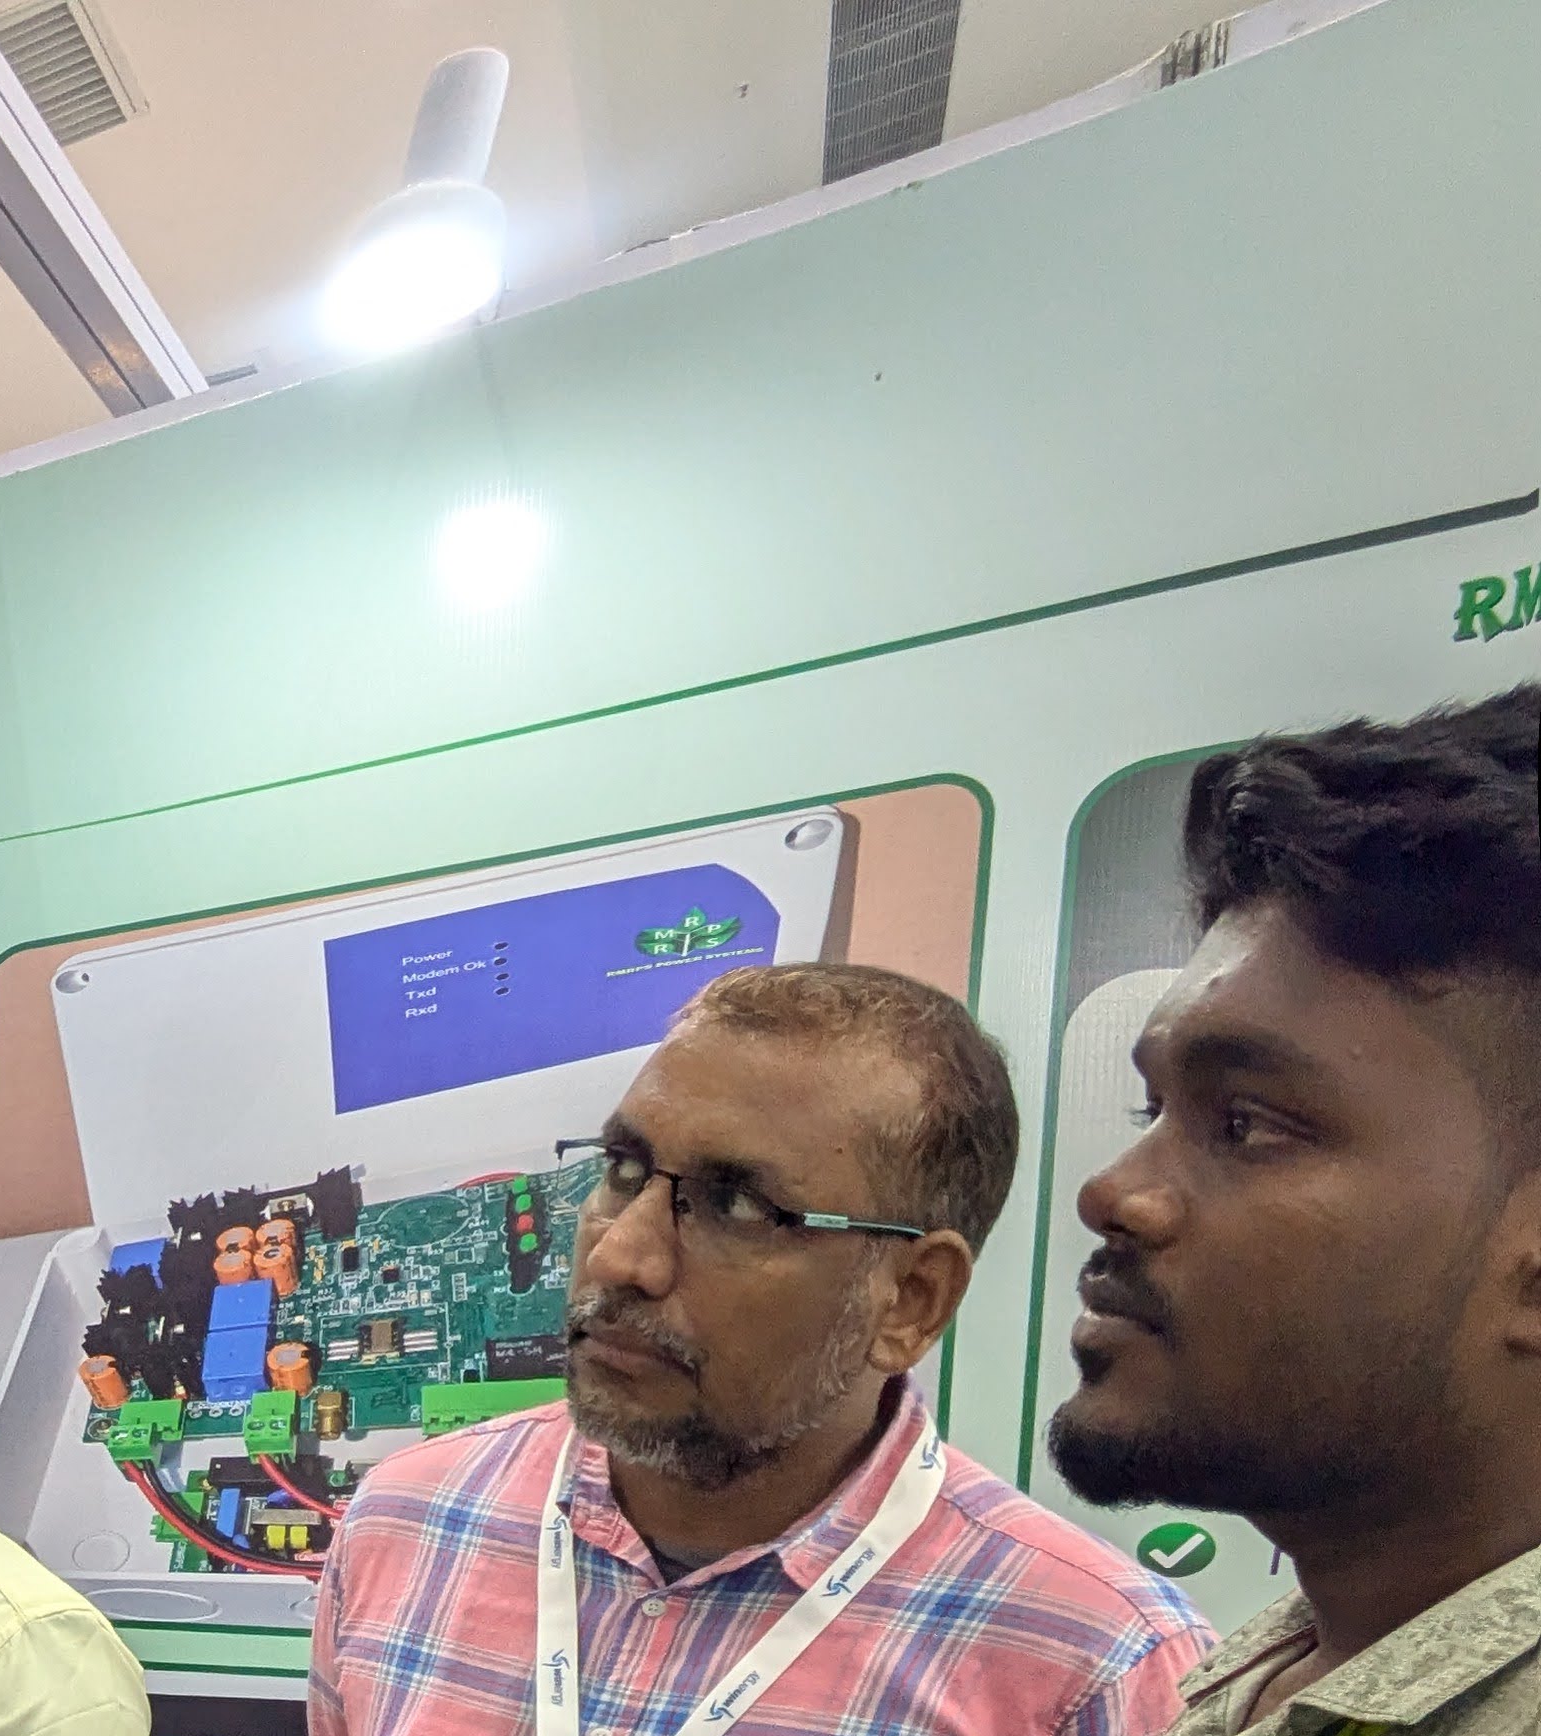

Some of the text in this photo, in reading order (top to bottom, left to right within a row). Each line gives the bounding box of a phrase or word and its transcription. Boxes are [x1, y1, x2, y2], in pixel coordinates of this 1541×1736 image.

[683, 916, 700, 928] R
[654, 924, 722, 940] M P
[653, 937, 719, 955] R S
[402, 951, 453, 967] Power
[402, 961, 487, 984] Modem Ok
[405, 987, 437, 1000] Txd
[405, 1004, 438, 1019] Rxd
